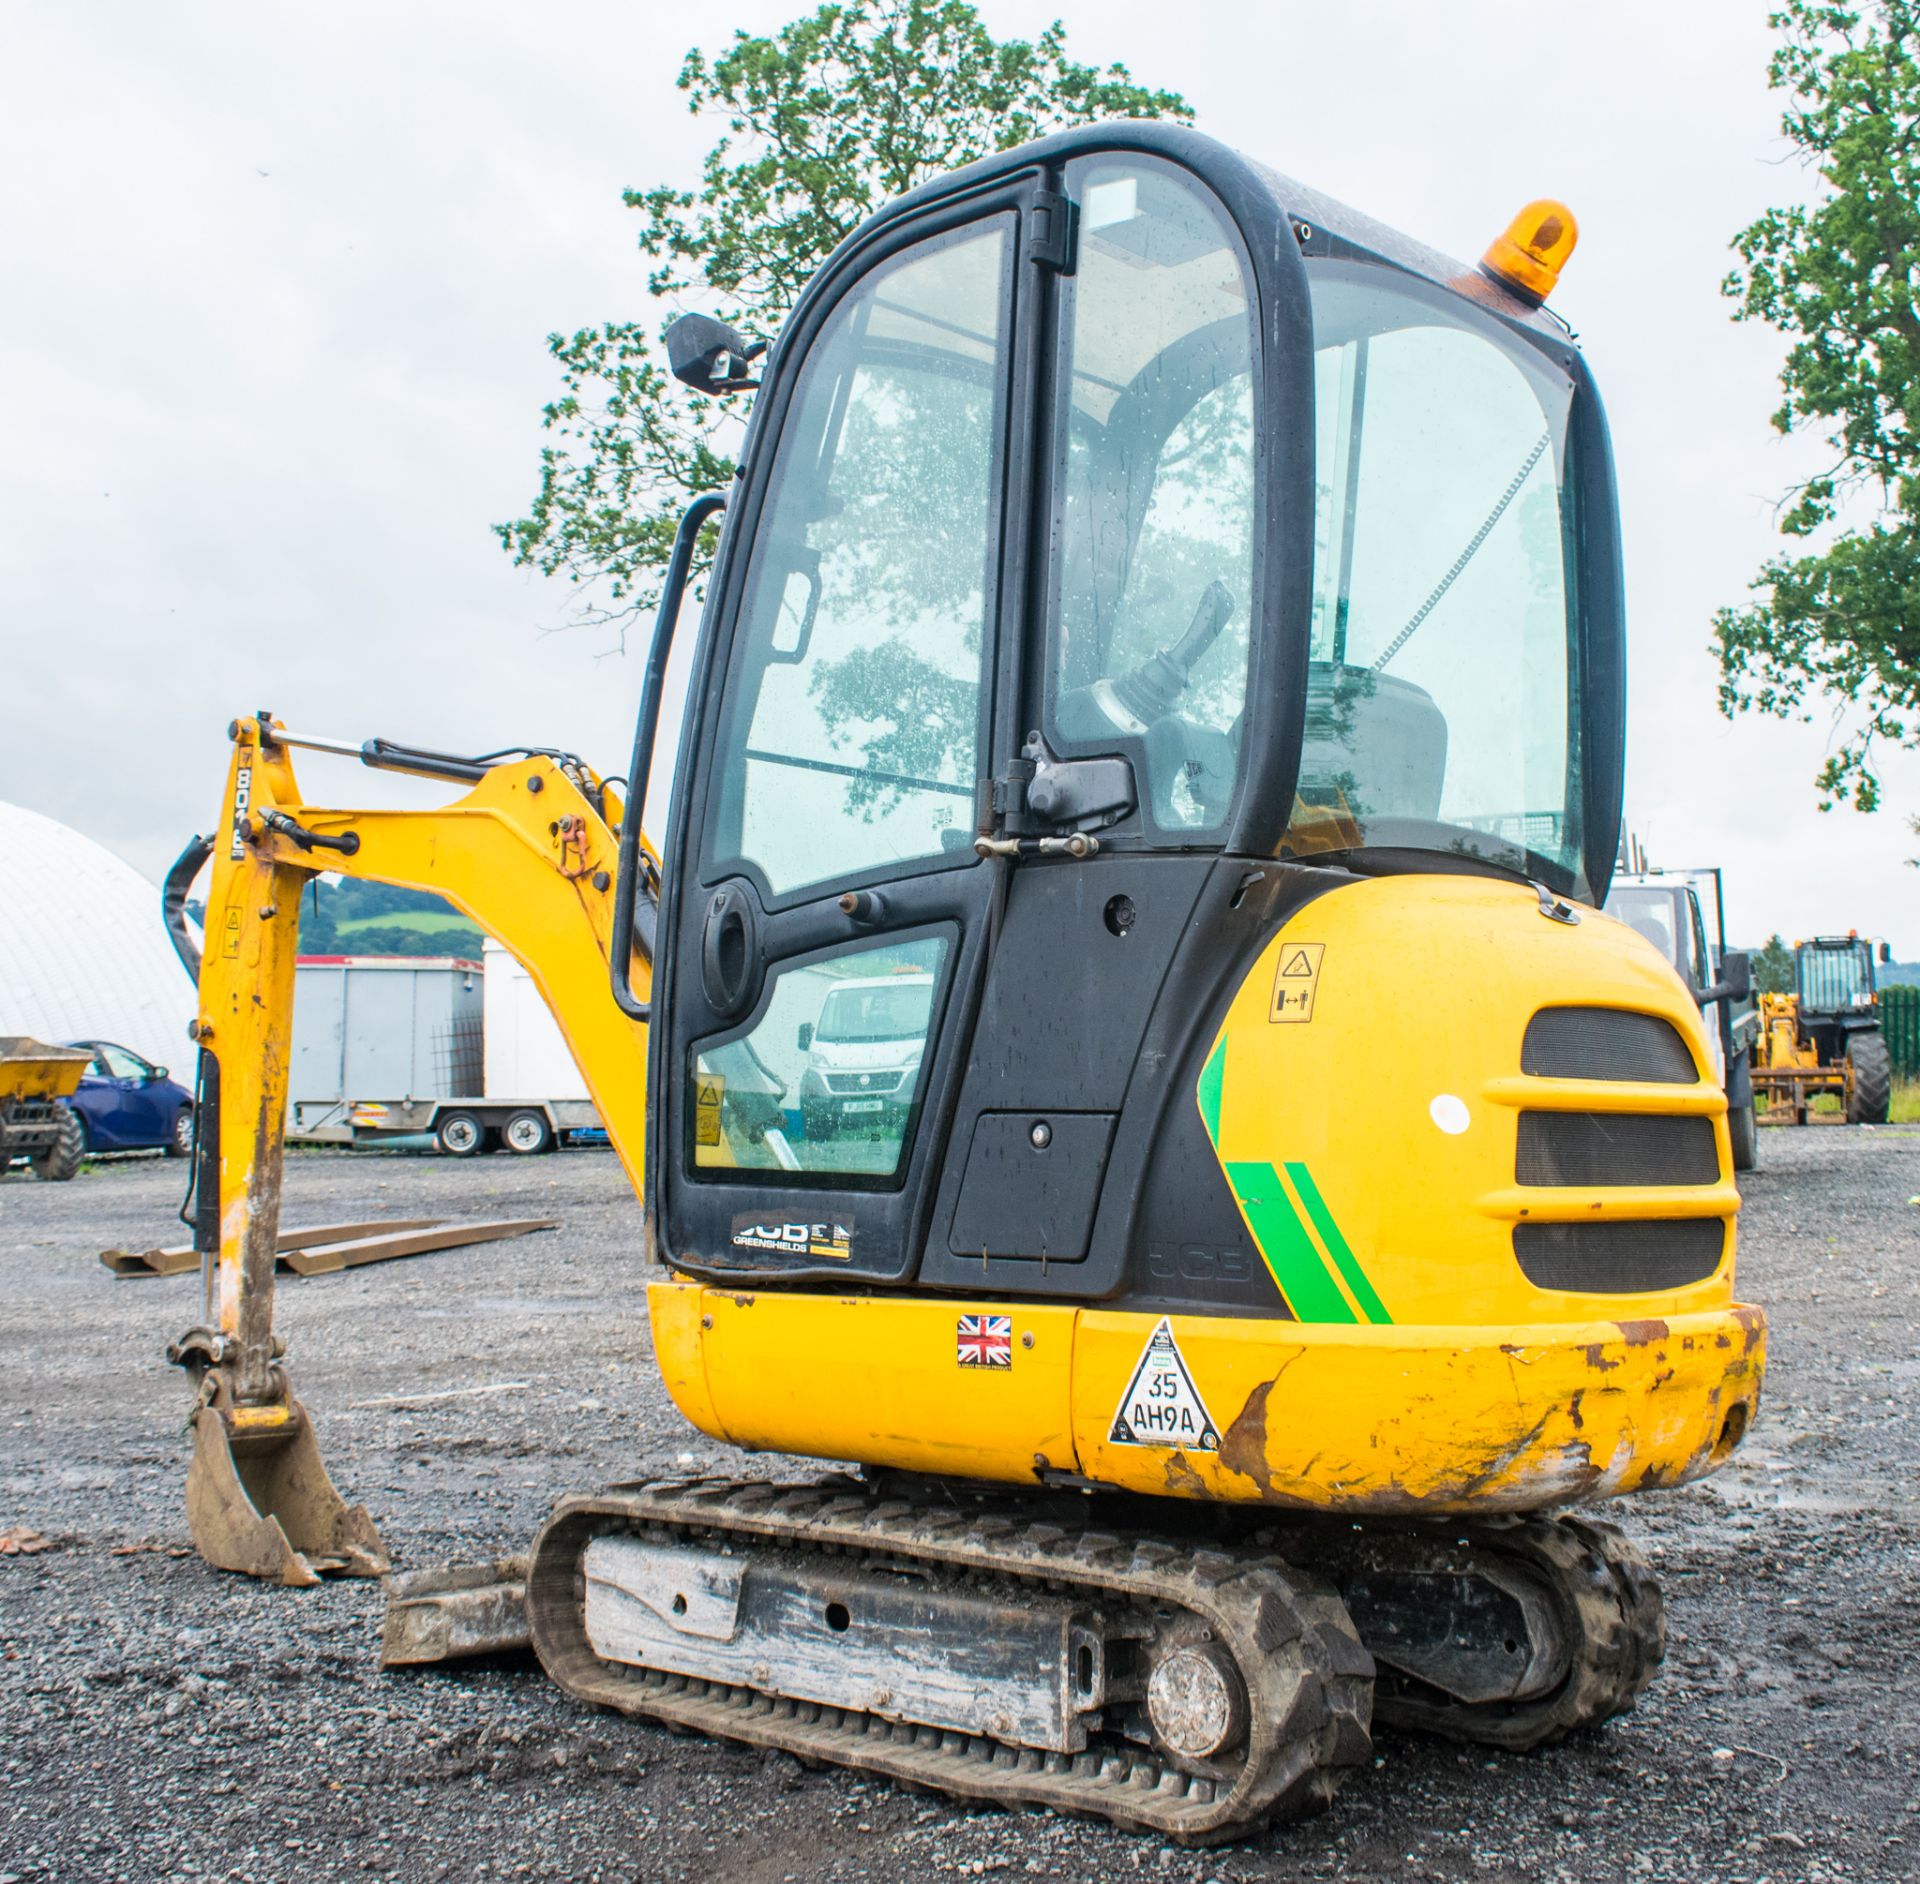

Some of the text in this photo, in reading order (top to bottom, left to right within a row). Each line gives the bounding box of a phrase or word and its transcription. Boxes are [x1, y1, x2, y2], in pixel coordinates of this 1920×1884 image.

[733, 1236, 807, 1253] GREENSHIELDS
[1149, 1241, 1250, 1282] JCB
[1148, 1372, 1178, 1399] 35
[1134, 1403, 1195, 1434] AH9A
